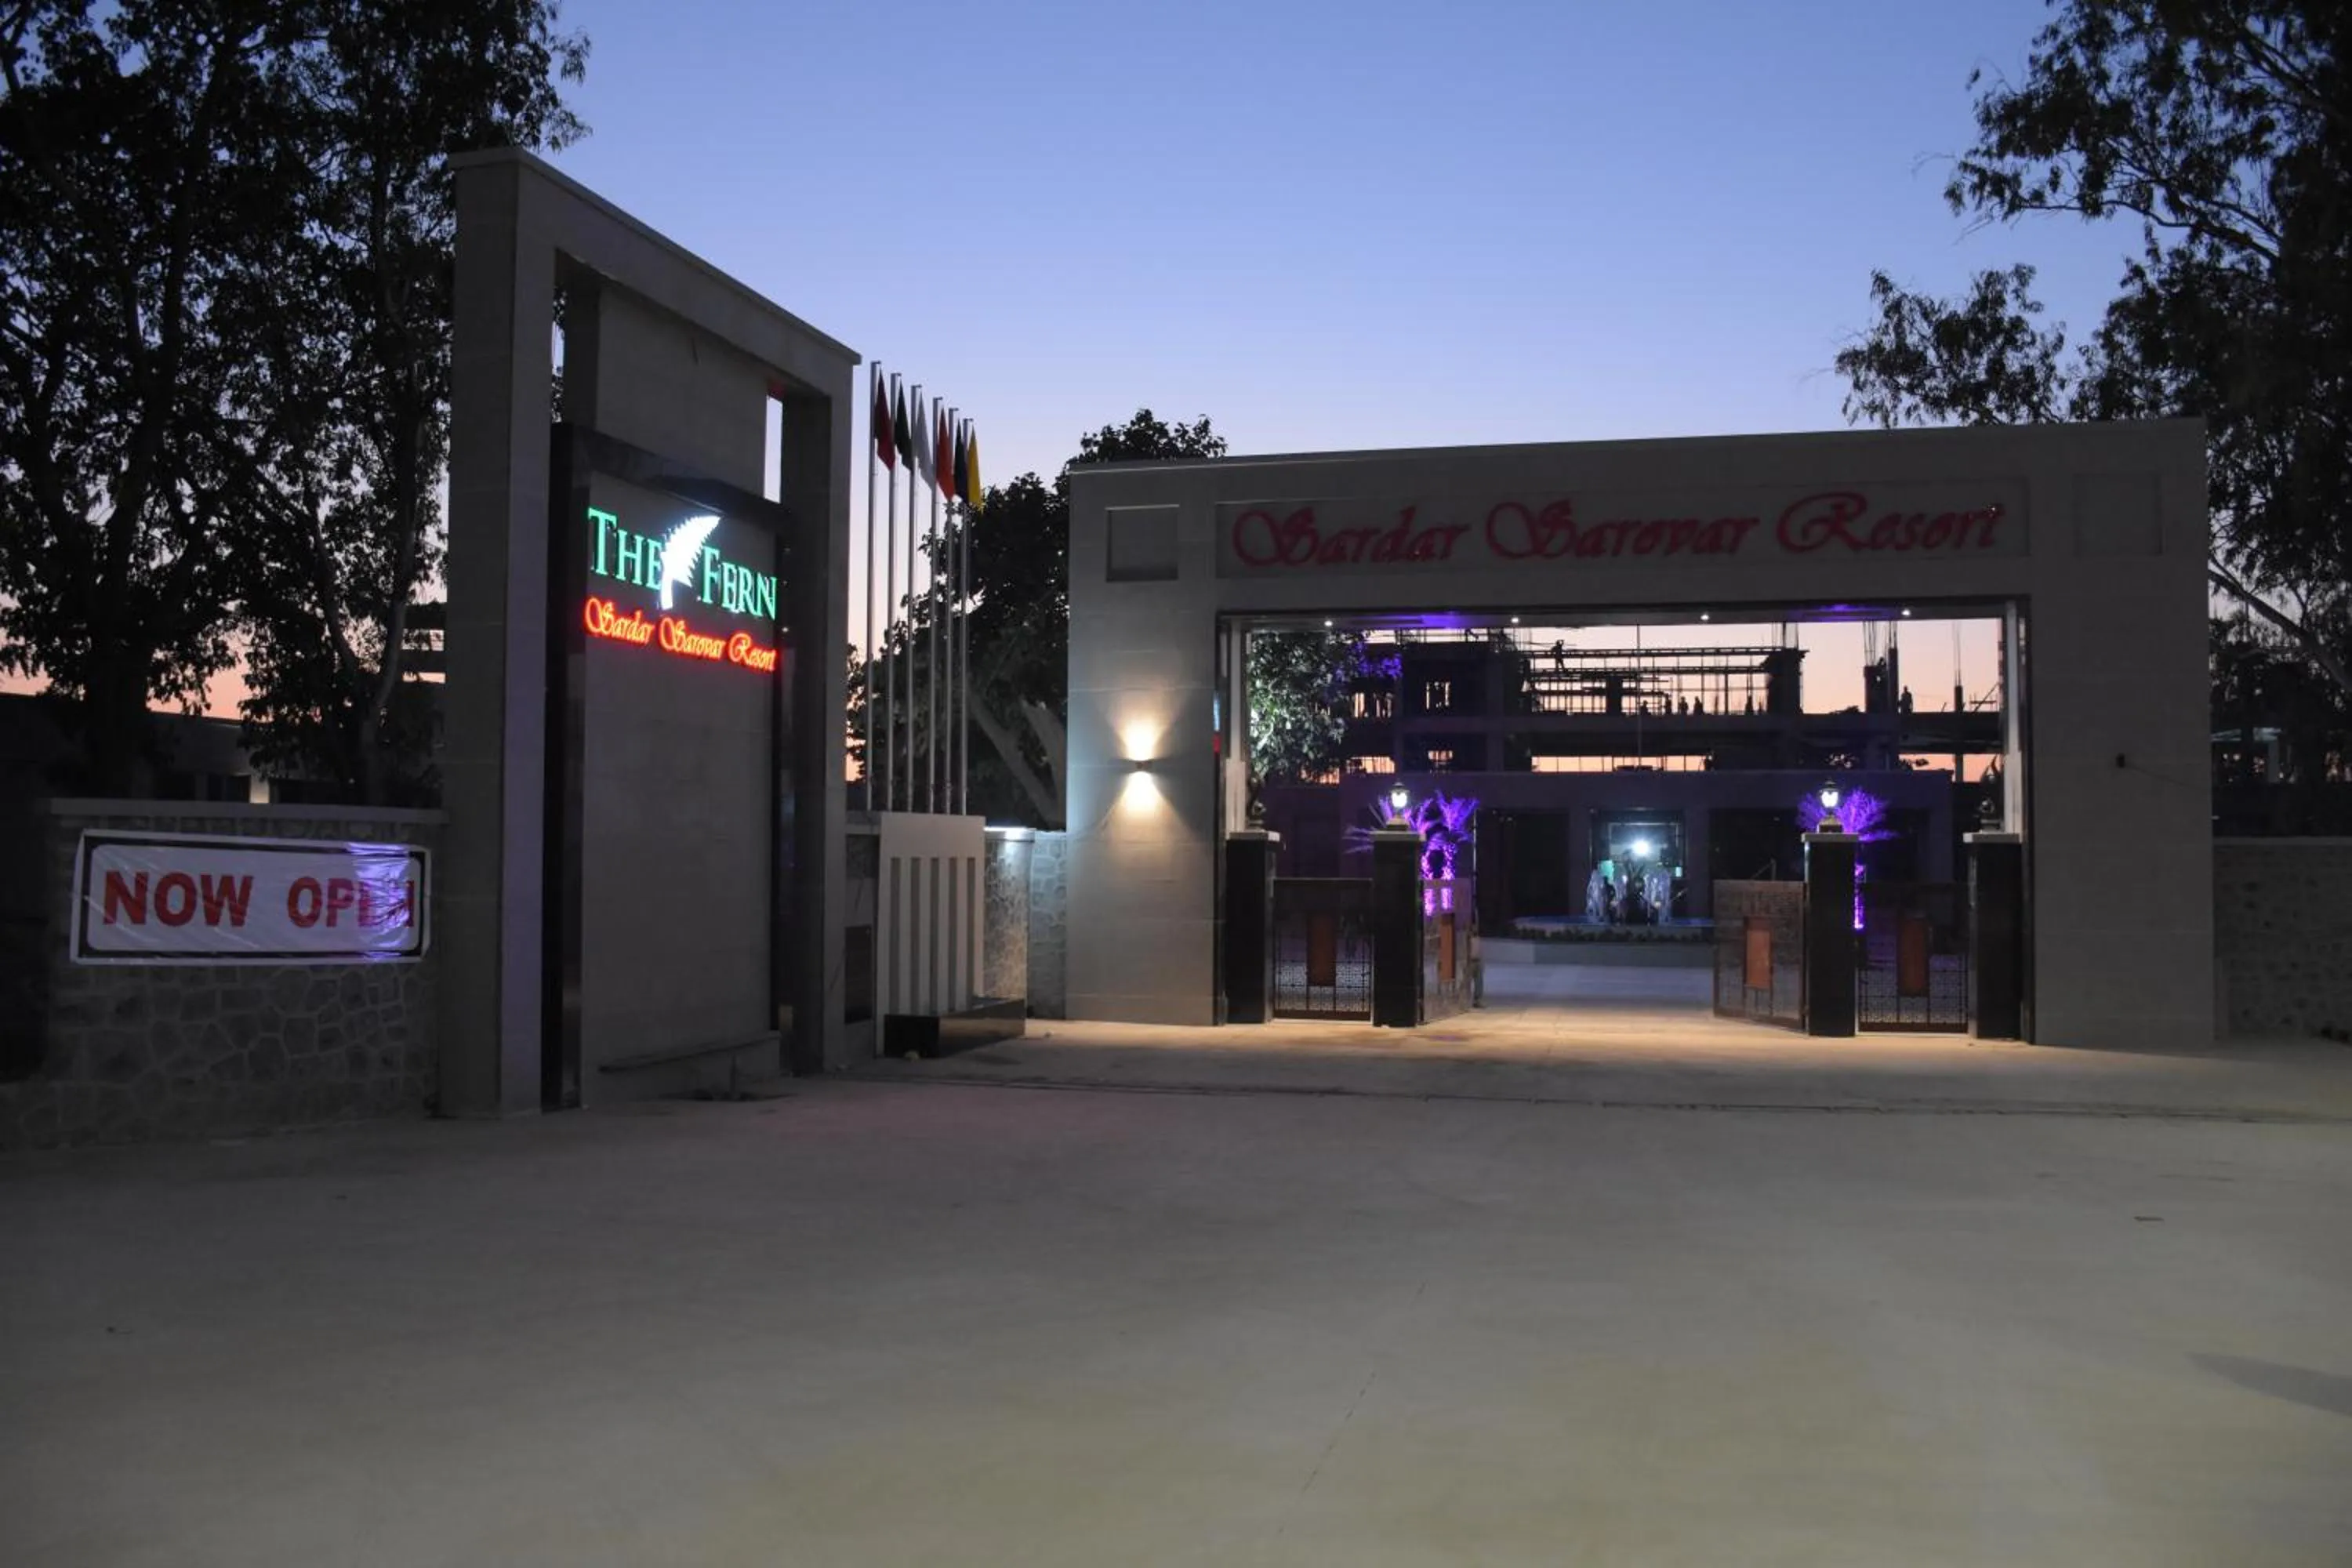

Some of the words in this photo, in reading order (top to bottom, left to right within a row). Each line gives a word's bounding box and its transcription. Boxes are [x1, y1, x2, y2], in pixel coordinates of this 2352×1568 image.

[588, 508, 663, 590] THE
[701, 546, 778, 620] FERN
[1232, 504, 1472, 567] Sardar
[1485, 497, 1761, 559] Sarovar
[1776, 490, 2008, 554] Resort
[585, 597, 655, 644] Sardar
[659, 617, 727, 659] Sarovar
[728, 632, 777, 672] Resort
[103, 870, 254, 927] NOW
